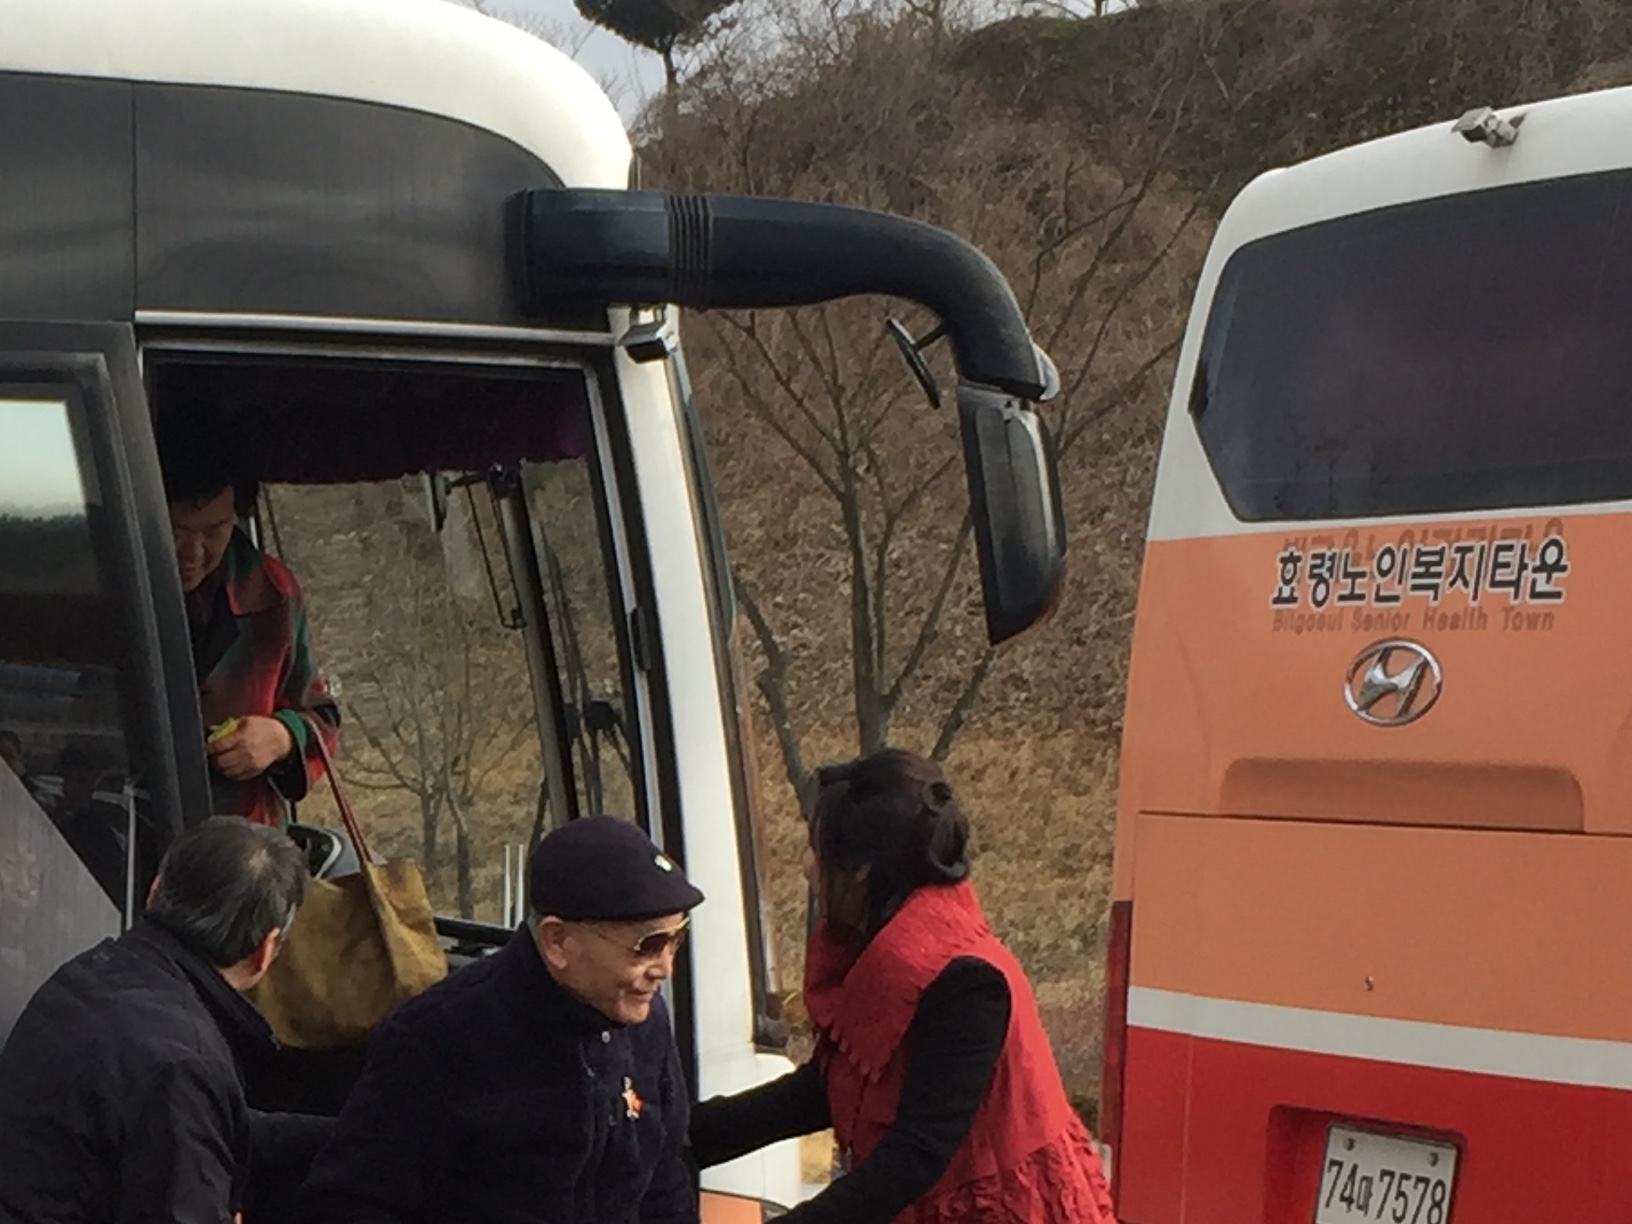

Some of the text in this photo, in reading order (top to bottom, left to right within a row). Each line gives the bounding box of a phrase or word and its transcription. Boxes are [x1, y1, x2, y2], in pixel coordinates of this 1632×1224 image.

[1272, 537, 1568, 609] 효령노인복지타운
[1350, 606, 1411, 633] Senior
[1421, 604, 1489, 632] Health
[1502, 605, 1556, 632] Town
